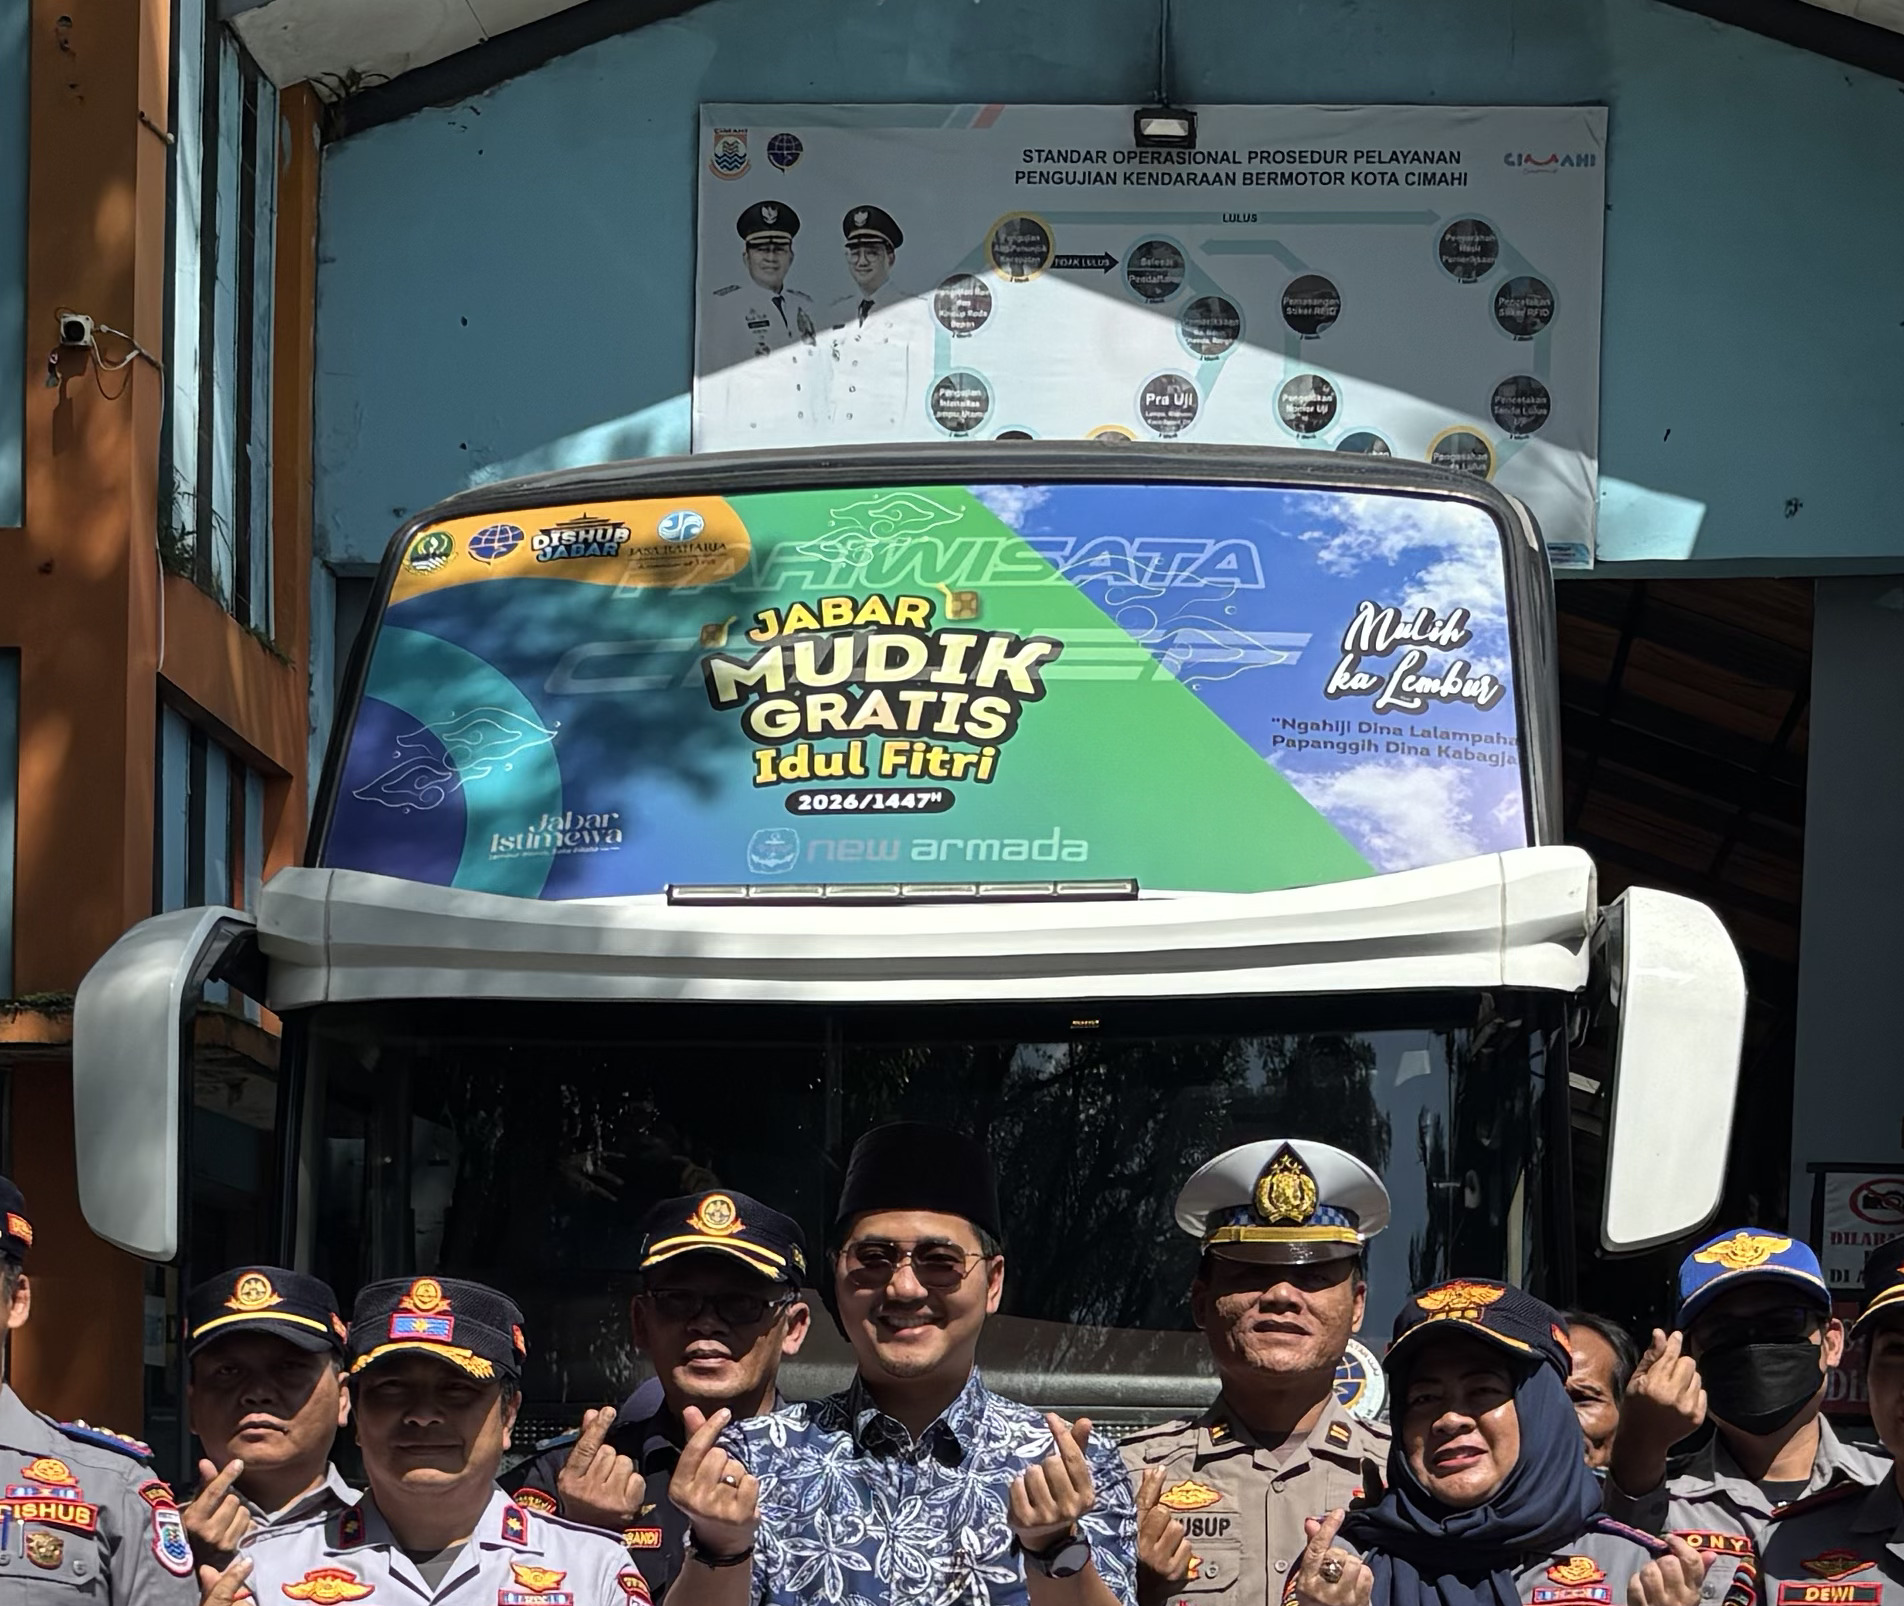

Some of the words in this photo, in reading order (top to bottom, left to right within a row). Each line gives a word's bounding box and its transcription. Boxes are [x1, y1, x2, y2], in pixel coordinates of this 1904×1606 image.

[1022, 149, 1107, 165] STANDAR
[1112, 149, 1242, 166] OPERASIONAL
[1247, 149, 1349, 166] PROSEDUR
[1353, 149, 1462, 166] PELAYANAN
[1015, 170, 1117, 187] PENGUJIAN
[1122, 170, 1237, 187] KENDARAAN
[1242, 170, 1345, 187] BERMOTOR
[1350, 170, 1399, 187] KOTA
[1404, 170, 1469, 187] CIMAHI
[1222, 212, 1258, 224] LULUS
[1145, 392, 1170, 406] Pra
[1173, 392, 1194, 409] Uji
[532, 527, 630, 550] DISHUB
[538, 542, 619, 562] JABAR
[748, 595, 932, 643] JABAR
[1344, 600, 1470, 653] Mulih
[709, 632, 1052, 704] MUDIK
[1327, 653, 1380, 696] ka
[1378, 651, 1502, 709] Lembur
[749, 689, 1012, 740] GRATIS
[1358, 721, 1404, 737] Dina
[1409, 724, 1519, 747] Lalampaha
[754, 739, 866, 784] Idul
[880, 741, 998, 782] Fitri
[1271, 734, 1379, 756] Papanggih
[1385, 740, 1431, 757] Dina
[1437, 745, 1520, 768] Kabagja
[538, 811, 620, 833] Jabar
[490, 826, 623, 853] Istimewa
[806, 836, 900, 863] new
[910, 826, 1089, 863] armada
[1179, 1516, 1231, 1538] USUP
[1686, 1533, 1745, 1553] ONY
[1803, 1585, 1857, 1603] DEWI
